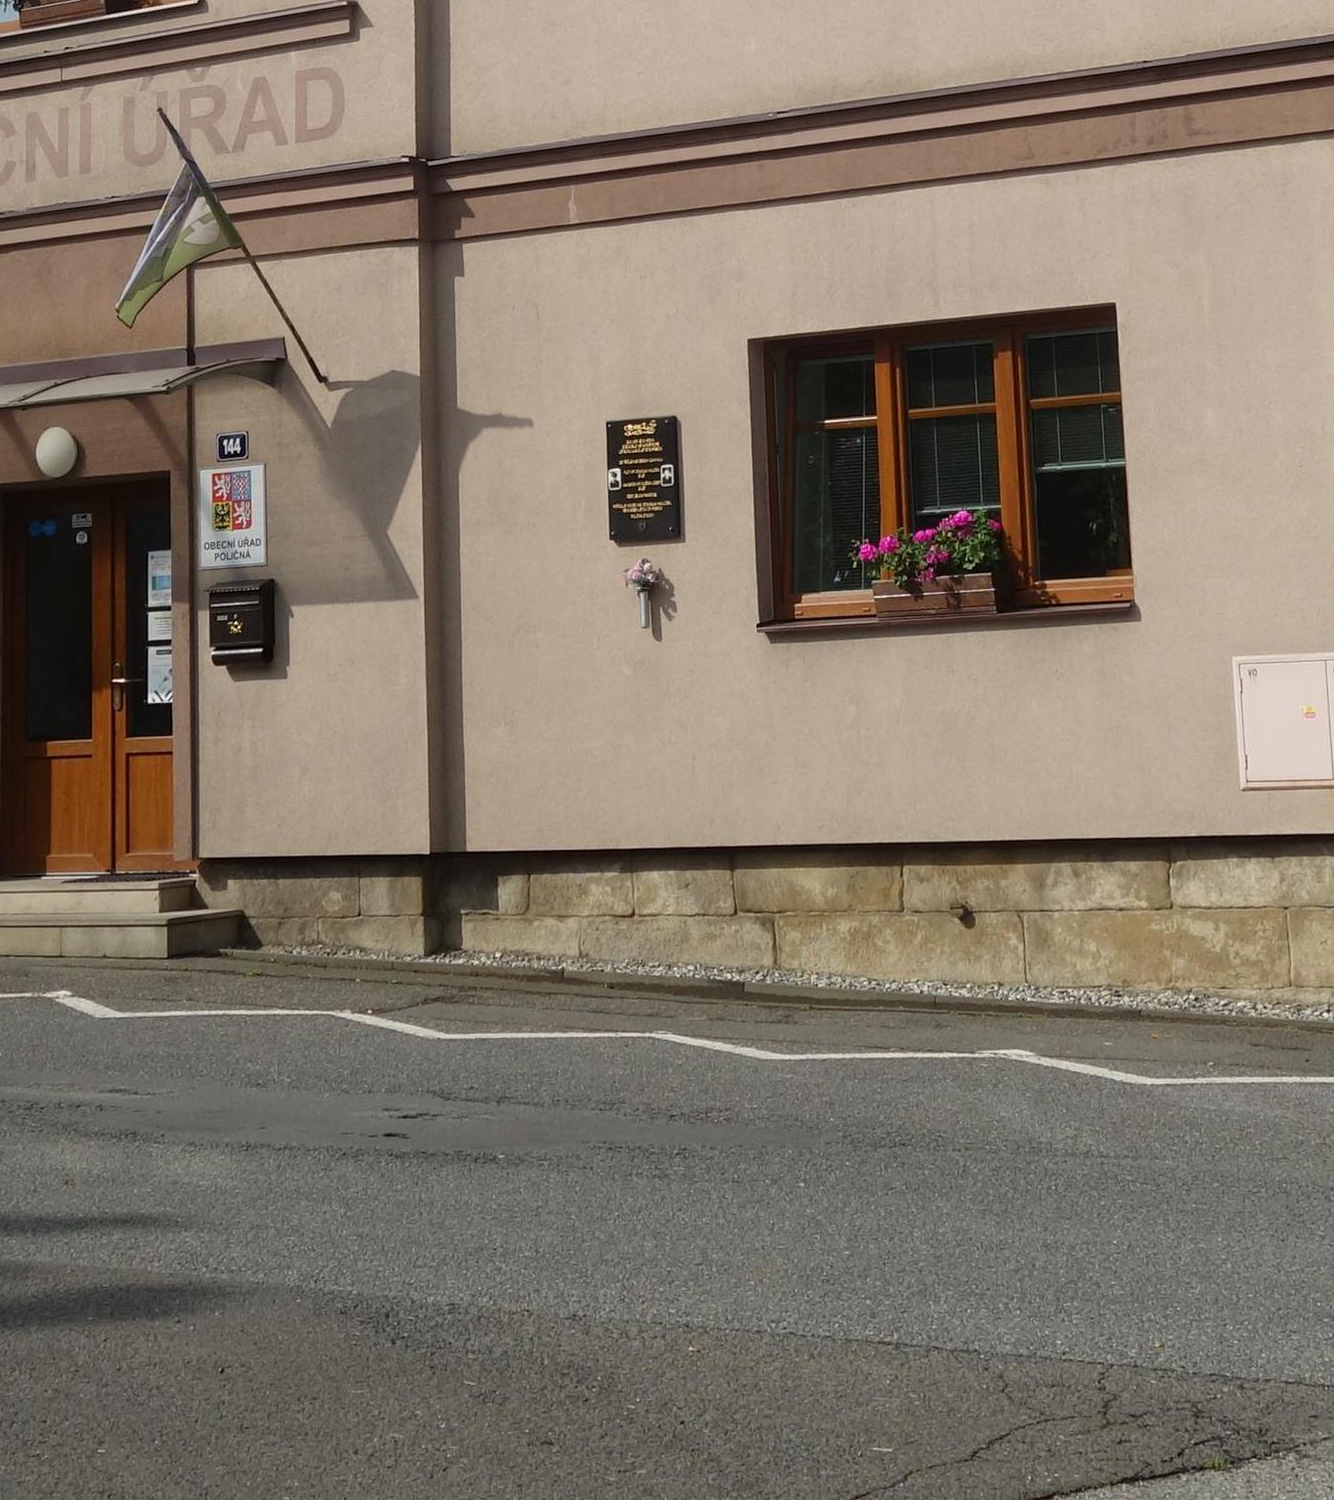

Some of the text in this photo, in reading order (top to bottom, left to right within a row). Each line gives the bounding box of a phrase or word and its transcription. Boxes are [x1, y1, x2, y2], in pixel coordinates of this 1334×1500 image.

[122, 66, 346, 167] ÚŘAD
[223, 438, 241, 455] 144
[204, 538, 236, 551] OBECNÍ
[214, 549, 252, 562] POLIČNÁ
